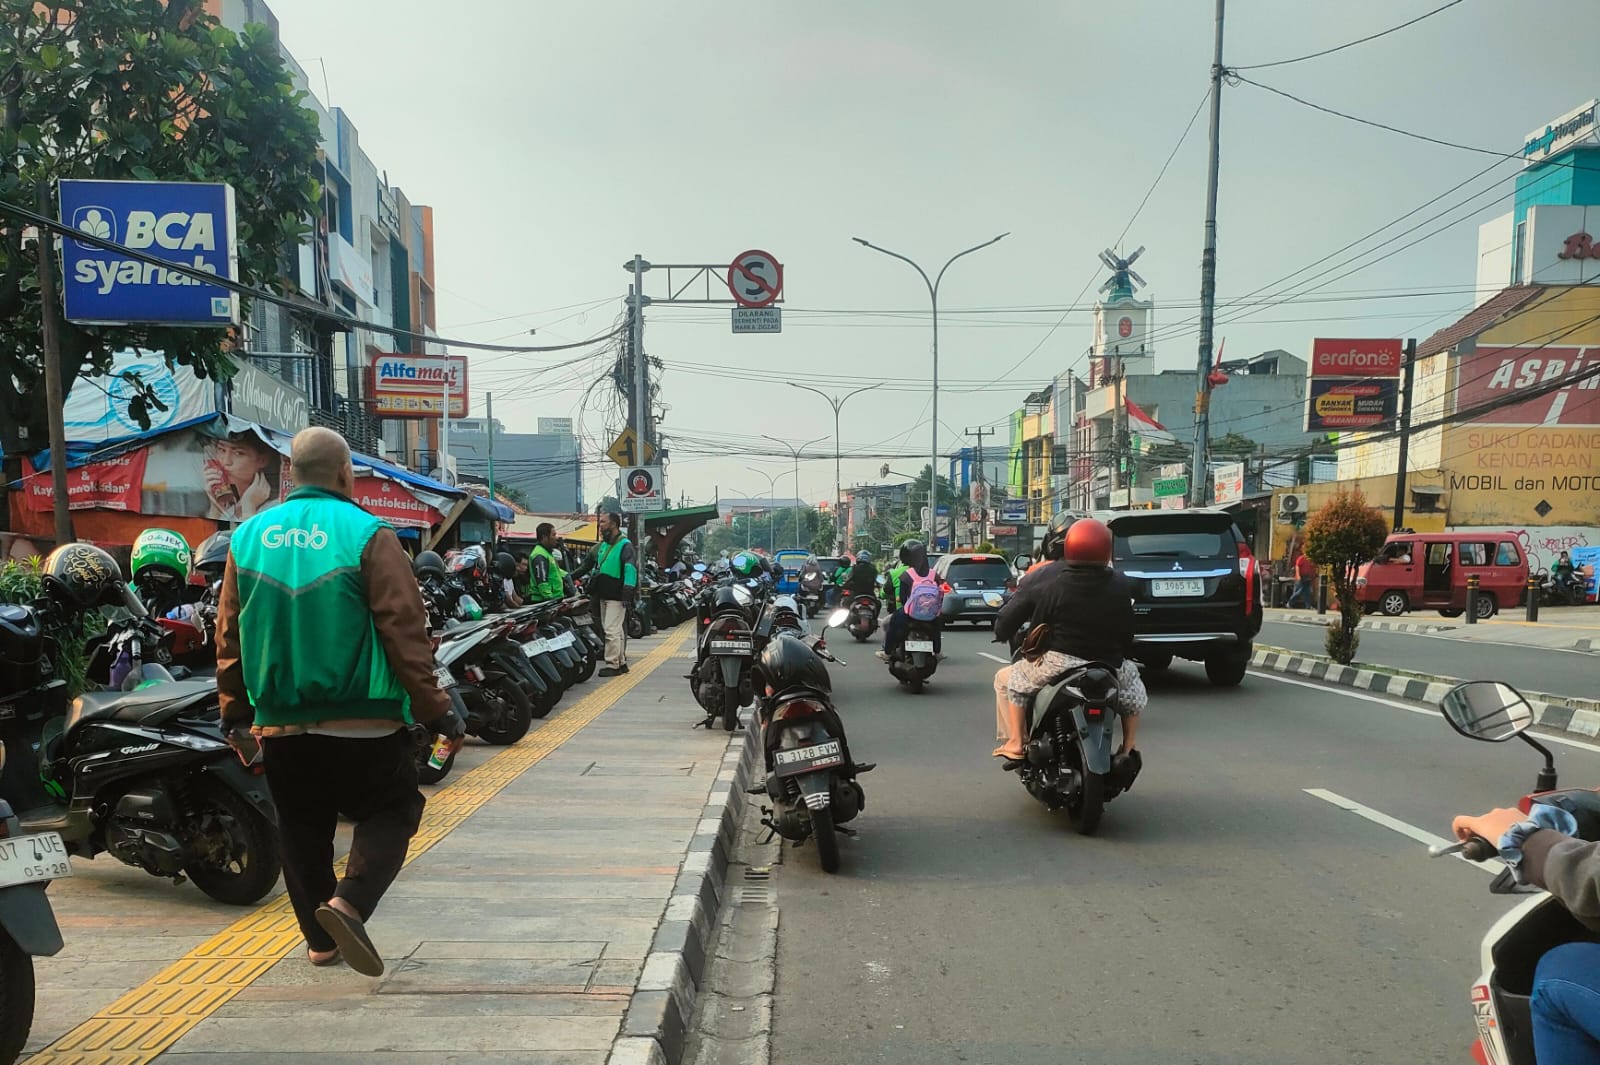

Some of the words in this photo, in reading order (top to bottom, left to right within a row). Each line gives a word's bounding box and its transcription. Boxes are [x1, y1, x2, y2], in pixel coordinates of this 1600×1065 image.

[124, 210, 216, 251] BCA
[74, 254, 217, 295] syariah
[738, 310, 774, 318] DILARANG
[1320, 349, 1390, 366] erafone
[1468, 433, 1519, 449] SUKU
[1477, 453, 1592, 469] KENDARAAN
[81, 470, 90, 481] &
[1450, 475, 1507, 491] MOBIL
[1514, 476, 1545, 491] dan
[381, 482, 391, 493] &
[361, 495, 429, 512] Antioksidan
[262, 523, 328, 550] Grab
[1155, 583, 1161, 591] B
[1165, 582, 1185, 590] 1965
[120, 742, 160, 755] Genio
[778, 754, 784, 764] B
[790, 748, 815, 762] 3128
[27, 835, 63, 861] ZUE
